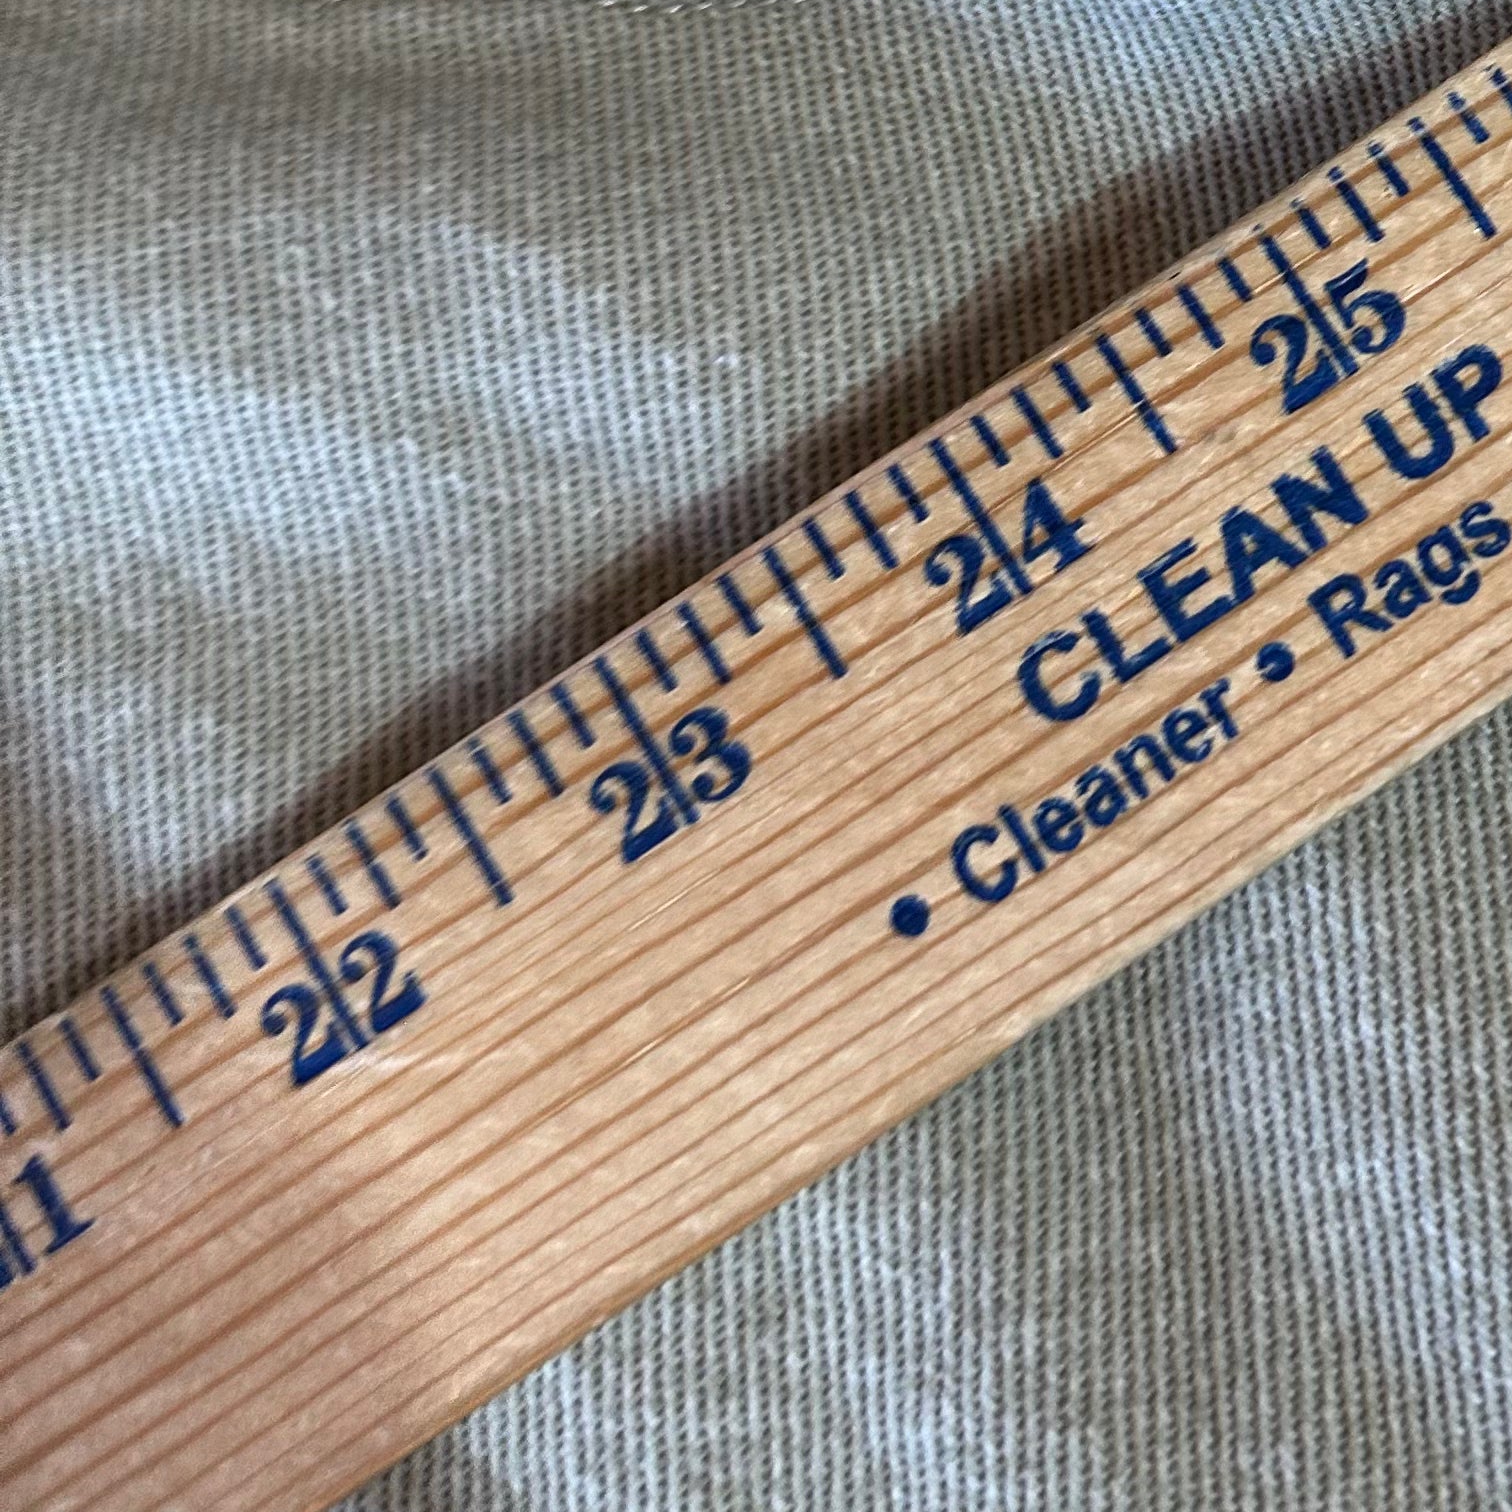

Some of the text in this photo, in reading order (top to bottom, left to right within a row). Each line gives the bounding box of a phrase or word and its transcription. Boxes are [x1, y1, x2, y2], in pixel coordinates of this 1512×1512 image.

[1249, 261, 1407, 414] 25
[925, 478, 1096, 636] 24
[1015, 344, 1504, 722] CLEAN UP
[949, 678, 1240, 903] Cleaner
[1307, 500, 1512, 658] Rags
[589, 707, 751, 864] 23
[260, 929, 427, 1086] 22
[0, 1158, 92, 1288] 1
